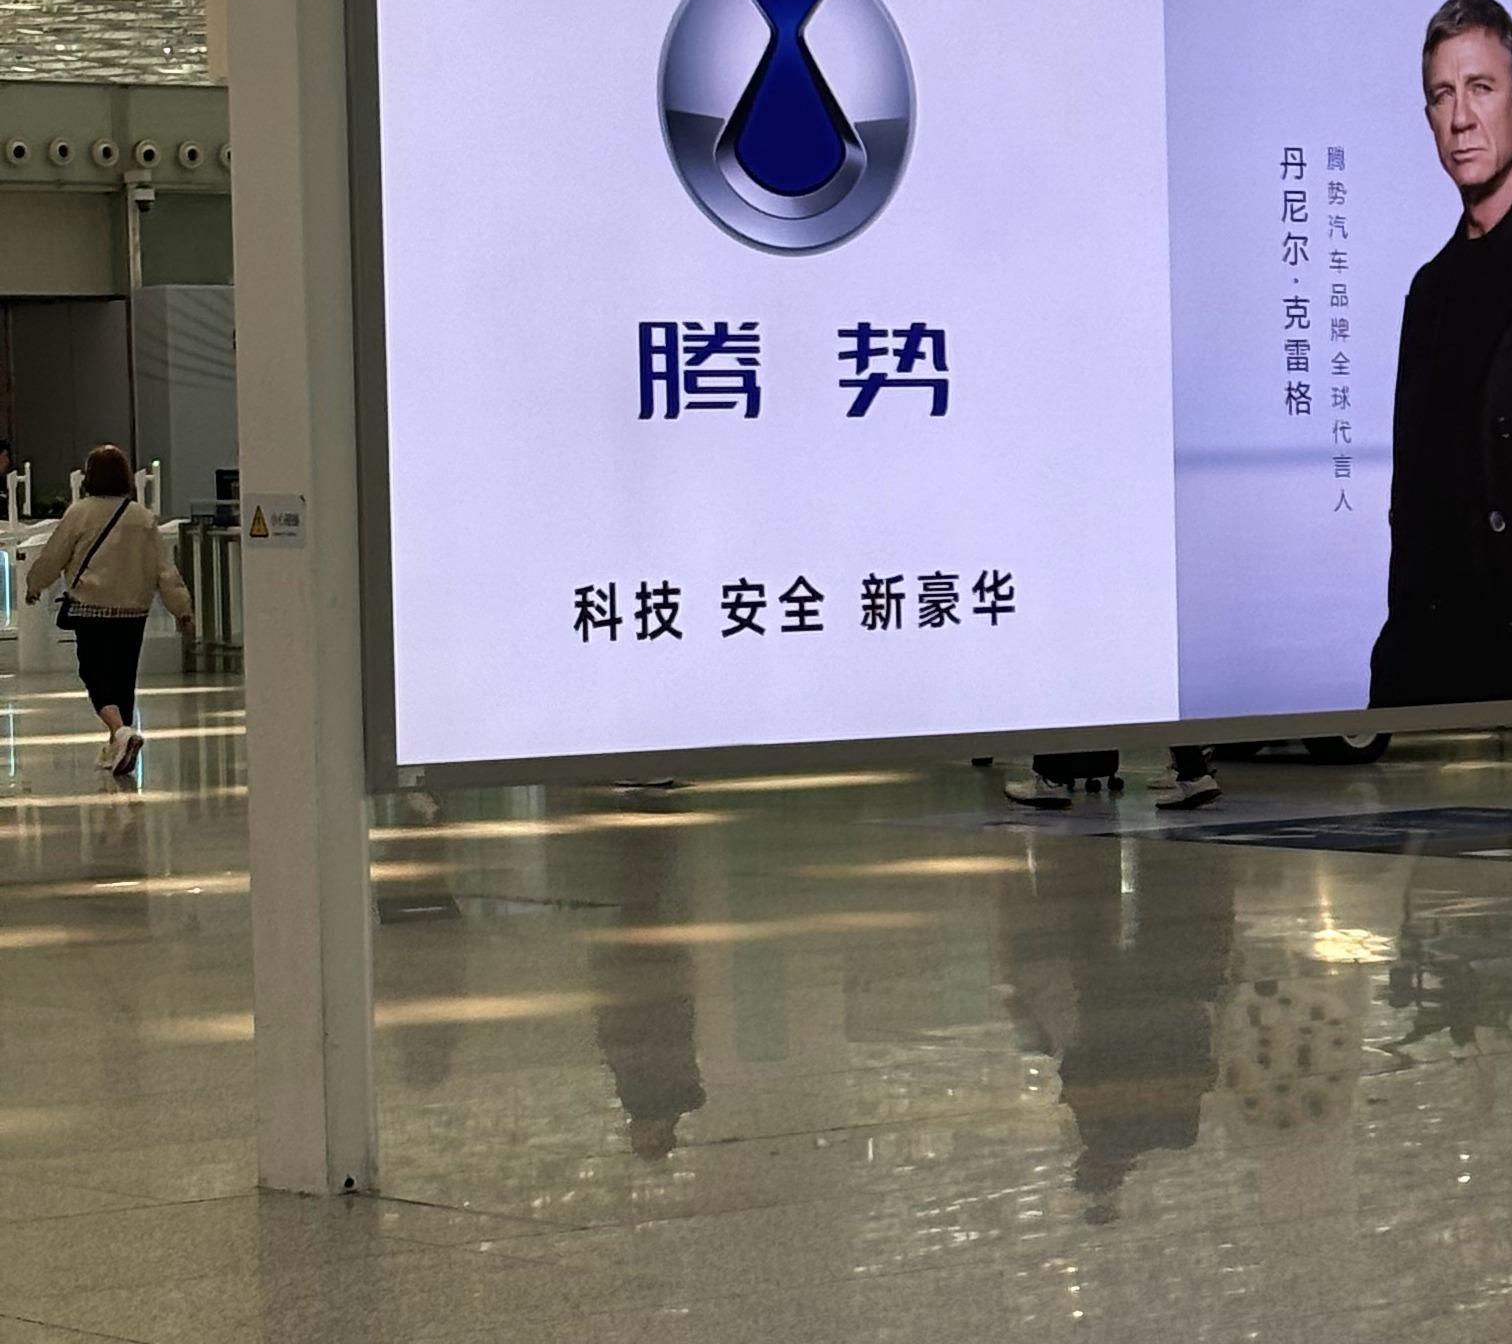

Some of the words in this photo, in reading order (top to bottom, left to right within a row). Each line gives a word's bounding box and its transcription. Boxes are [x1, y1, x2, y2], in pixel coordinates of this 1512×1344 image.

[637, 321, 950, 421] 腾势
[572, 579, 684, 644] 科技
[720, 574, 826, 639] 安全
[859, 567, 1017, 632] 新豪华
